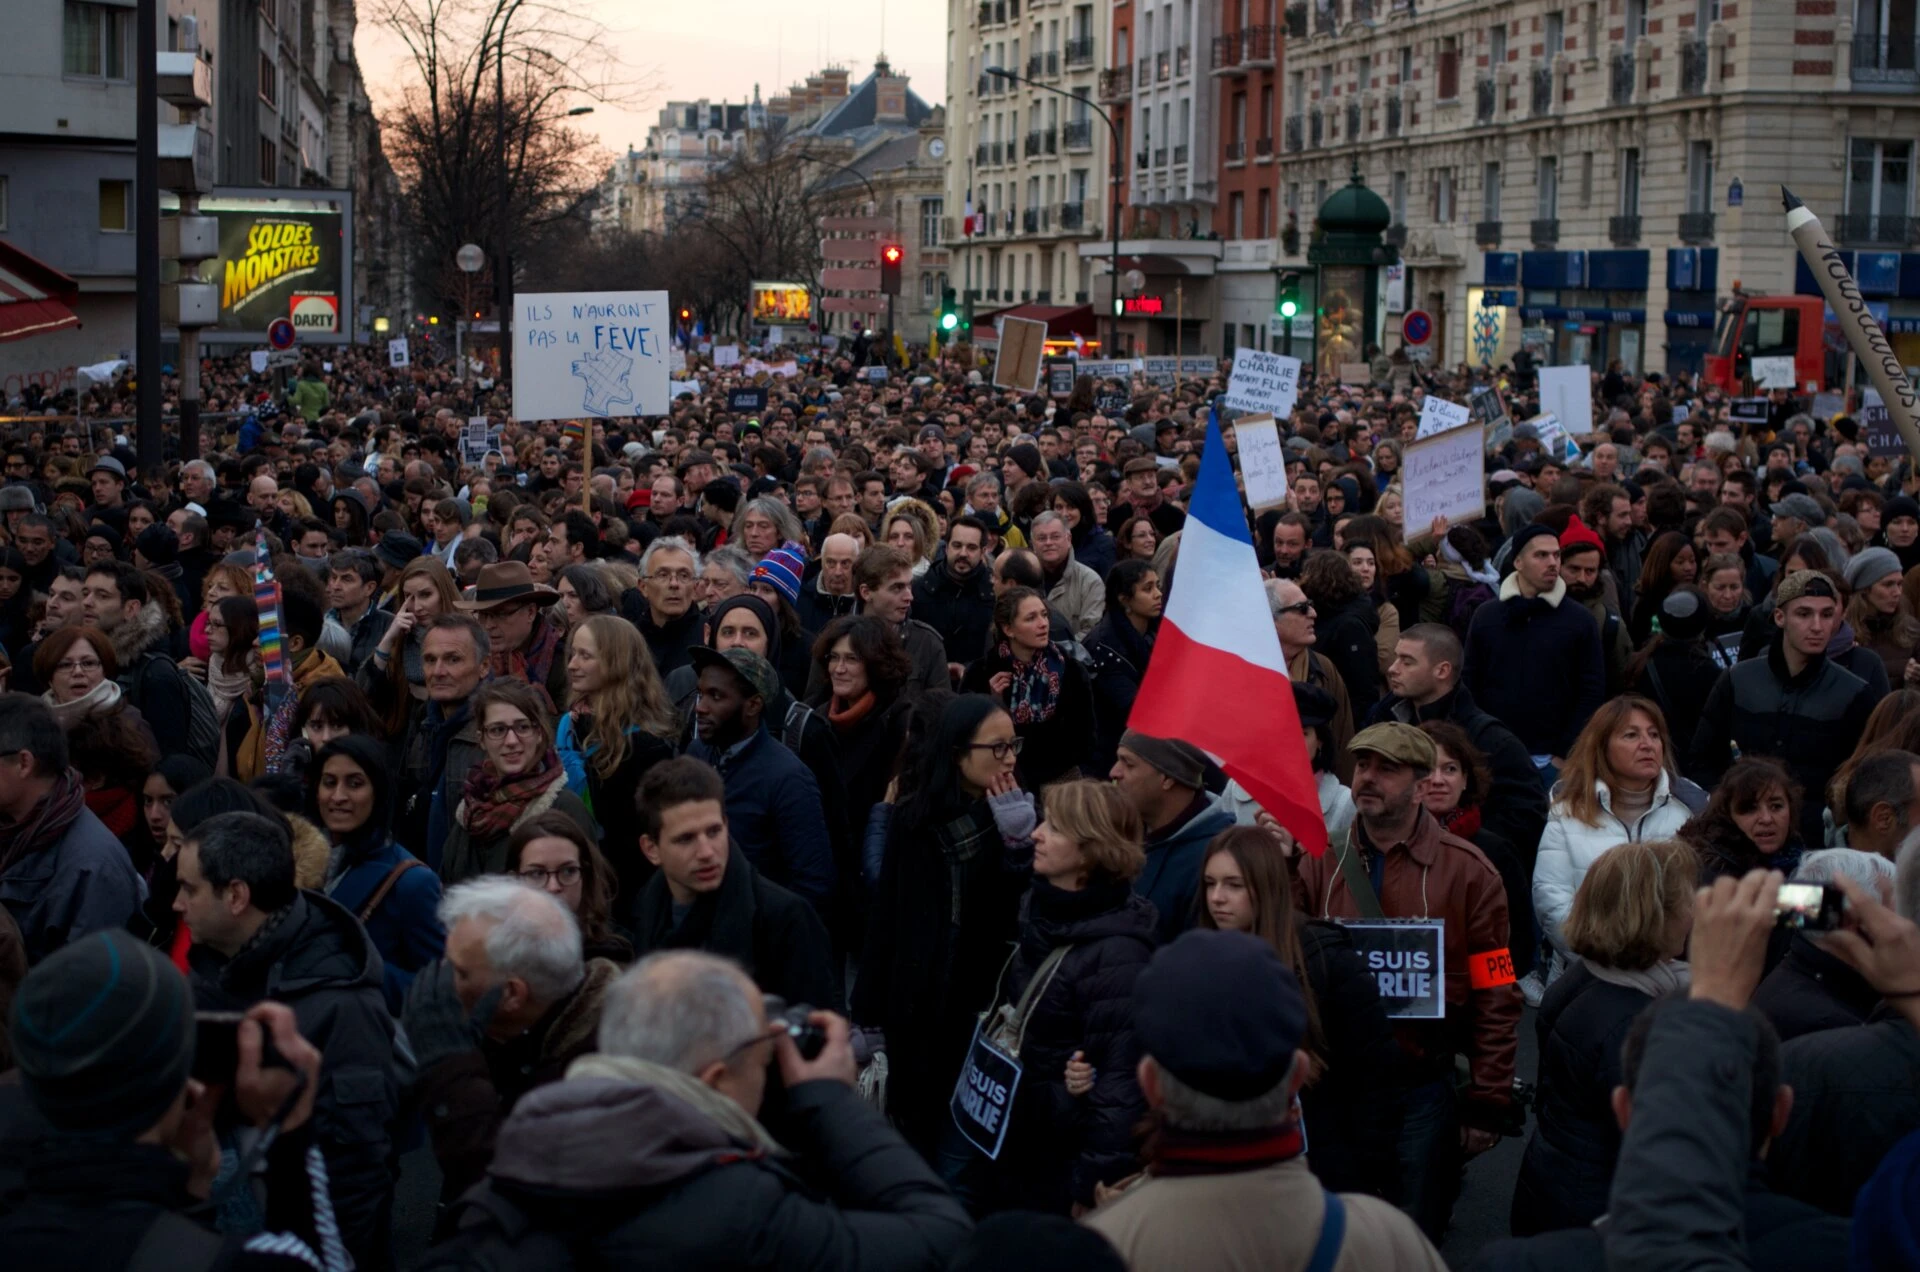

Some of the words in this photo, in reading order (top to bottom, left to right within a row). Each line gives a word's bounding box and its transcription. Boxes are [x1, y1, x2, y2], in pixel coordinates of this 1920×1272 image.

[245, 223, 313, 256] SOLDES
[222, 245, 320, 309] MONSTRES
[293, 313, 334, 327] DARTY
[527, 304, 553, 322] ILS
[573, 302, 656, 320] N'AURONT
[528, 328, 557, 349] PAS
[566, 330, 580, 345] LA
[1238, 358, 1294, 380] CHARLIE
[1262, 377, 1290, 393] FLIC
[1368, 950, 1431, 969] SUIS
[1371, 971, 1431, 997] RLIE
[968, 1064, 1007, 1106] SUIS
